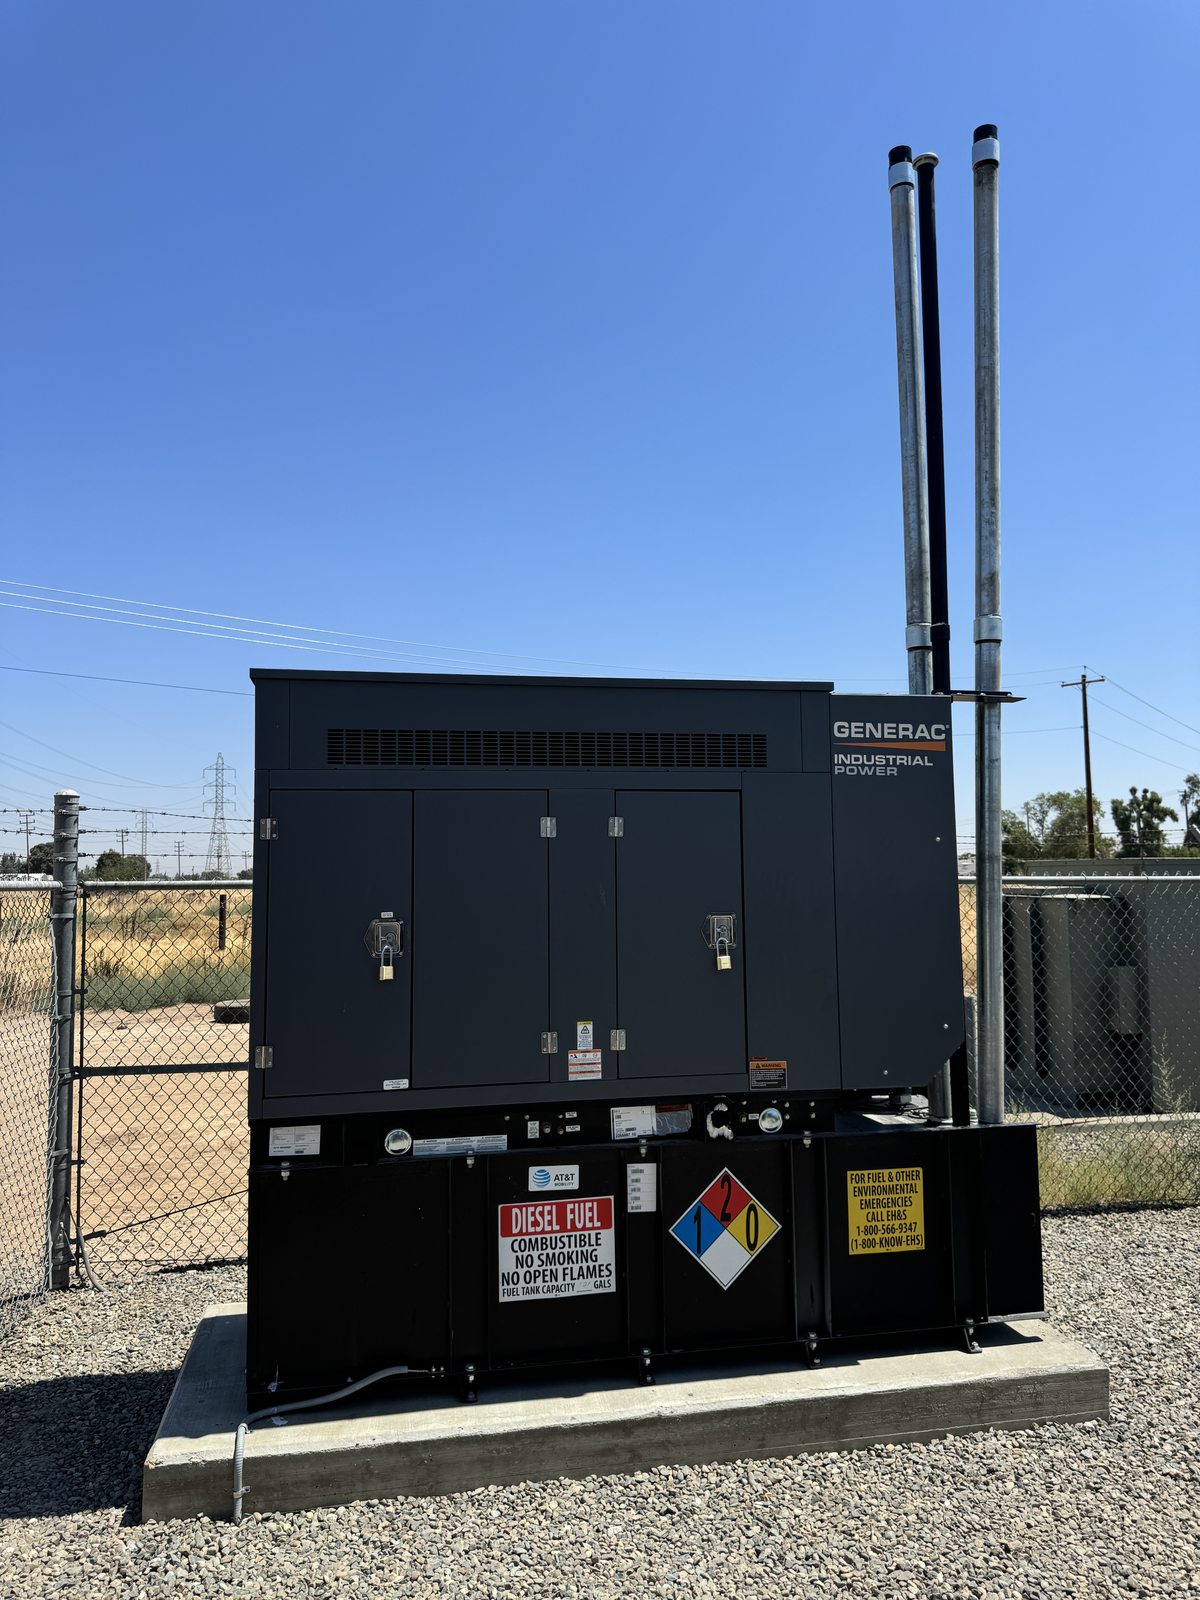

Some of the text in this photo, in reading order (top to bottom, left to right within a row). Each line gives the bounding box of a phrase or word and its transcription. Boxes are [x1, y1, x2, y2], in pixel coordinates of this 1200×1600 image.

[833, 721, 946, 740] GENERAC
[834, 754, 934, 766] INDUSTRIAL
[834, 765, 898, 776] POWER
[553, 1173, 576, 1182] AT&T
[850, 1170, 921, 1184] FOR FUEL & OTHER
[720, 1173, 732, 1222] 2
[853, 1183, 919, 1197] ENVIRONMENTAL
[860, 1196, 913, 1210] EMERGENCIES
[511, 1201, 601, 1234] DIESEL FUEL
[866, 1209, 907, 1223] CALL EH&S
[693, 1205, 702, 1254] 1
[745, 1202, 759, 1251] 0
[856, 1222, 918, 1236] 1-800-566-9347
[510, 1232, 602, 1253] COMBUSTIBLE
[850, 1234, 924, 1251] (1-800-KNOW-EHS)
[515, 1248, 598, 1269] NO SMOKING
[501, 1263, 612, 1286] NO OPEN FLAMES
[502, 1287, 520, 1297] FUEL
[521, 1285, 540, 1296] TANK
[541, 1283, 576, 1294] CAPACITY
[593, 1279, 612, 1289] GALS
